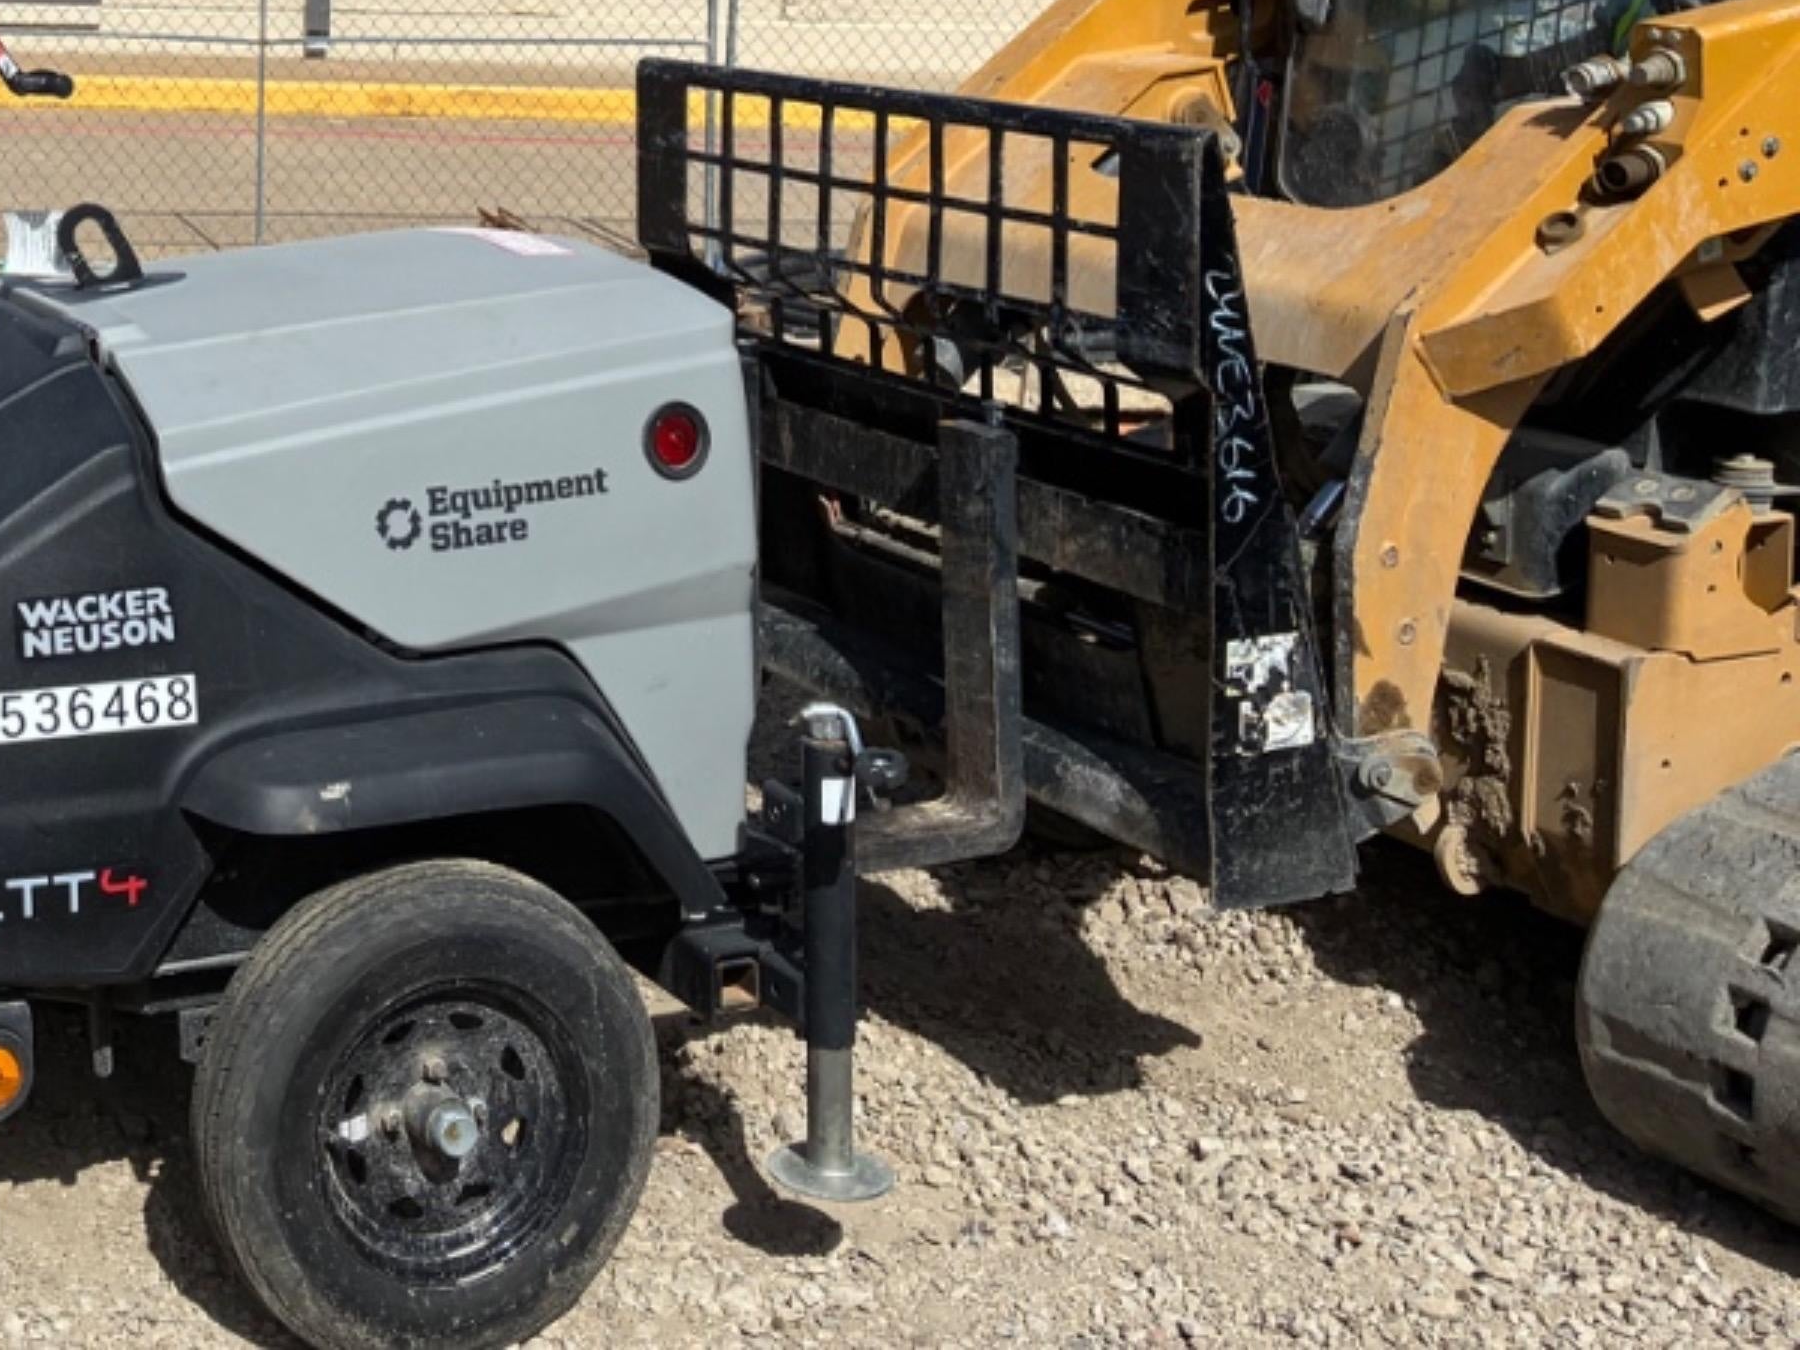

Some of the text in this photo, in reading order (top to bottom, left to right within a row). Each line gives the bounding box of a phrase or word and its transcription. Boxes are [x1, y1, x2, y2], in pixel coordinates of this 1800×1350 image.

[426, 467, 608, 519] Equipment
[430, 518, 529, 552] Share
[17, 586, 172, 628] WACKER
[22, 614, 176, 658] NEUSON
[0, 677, 194, 739] 536468
